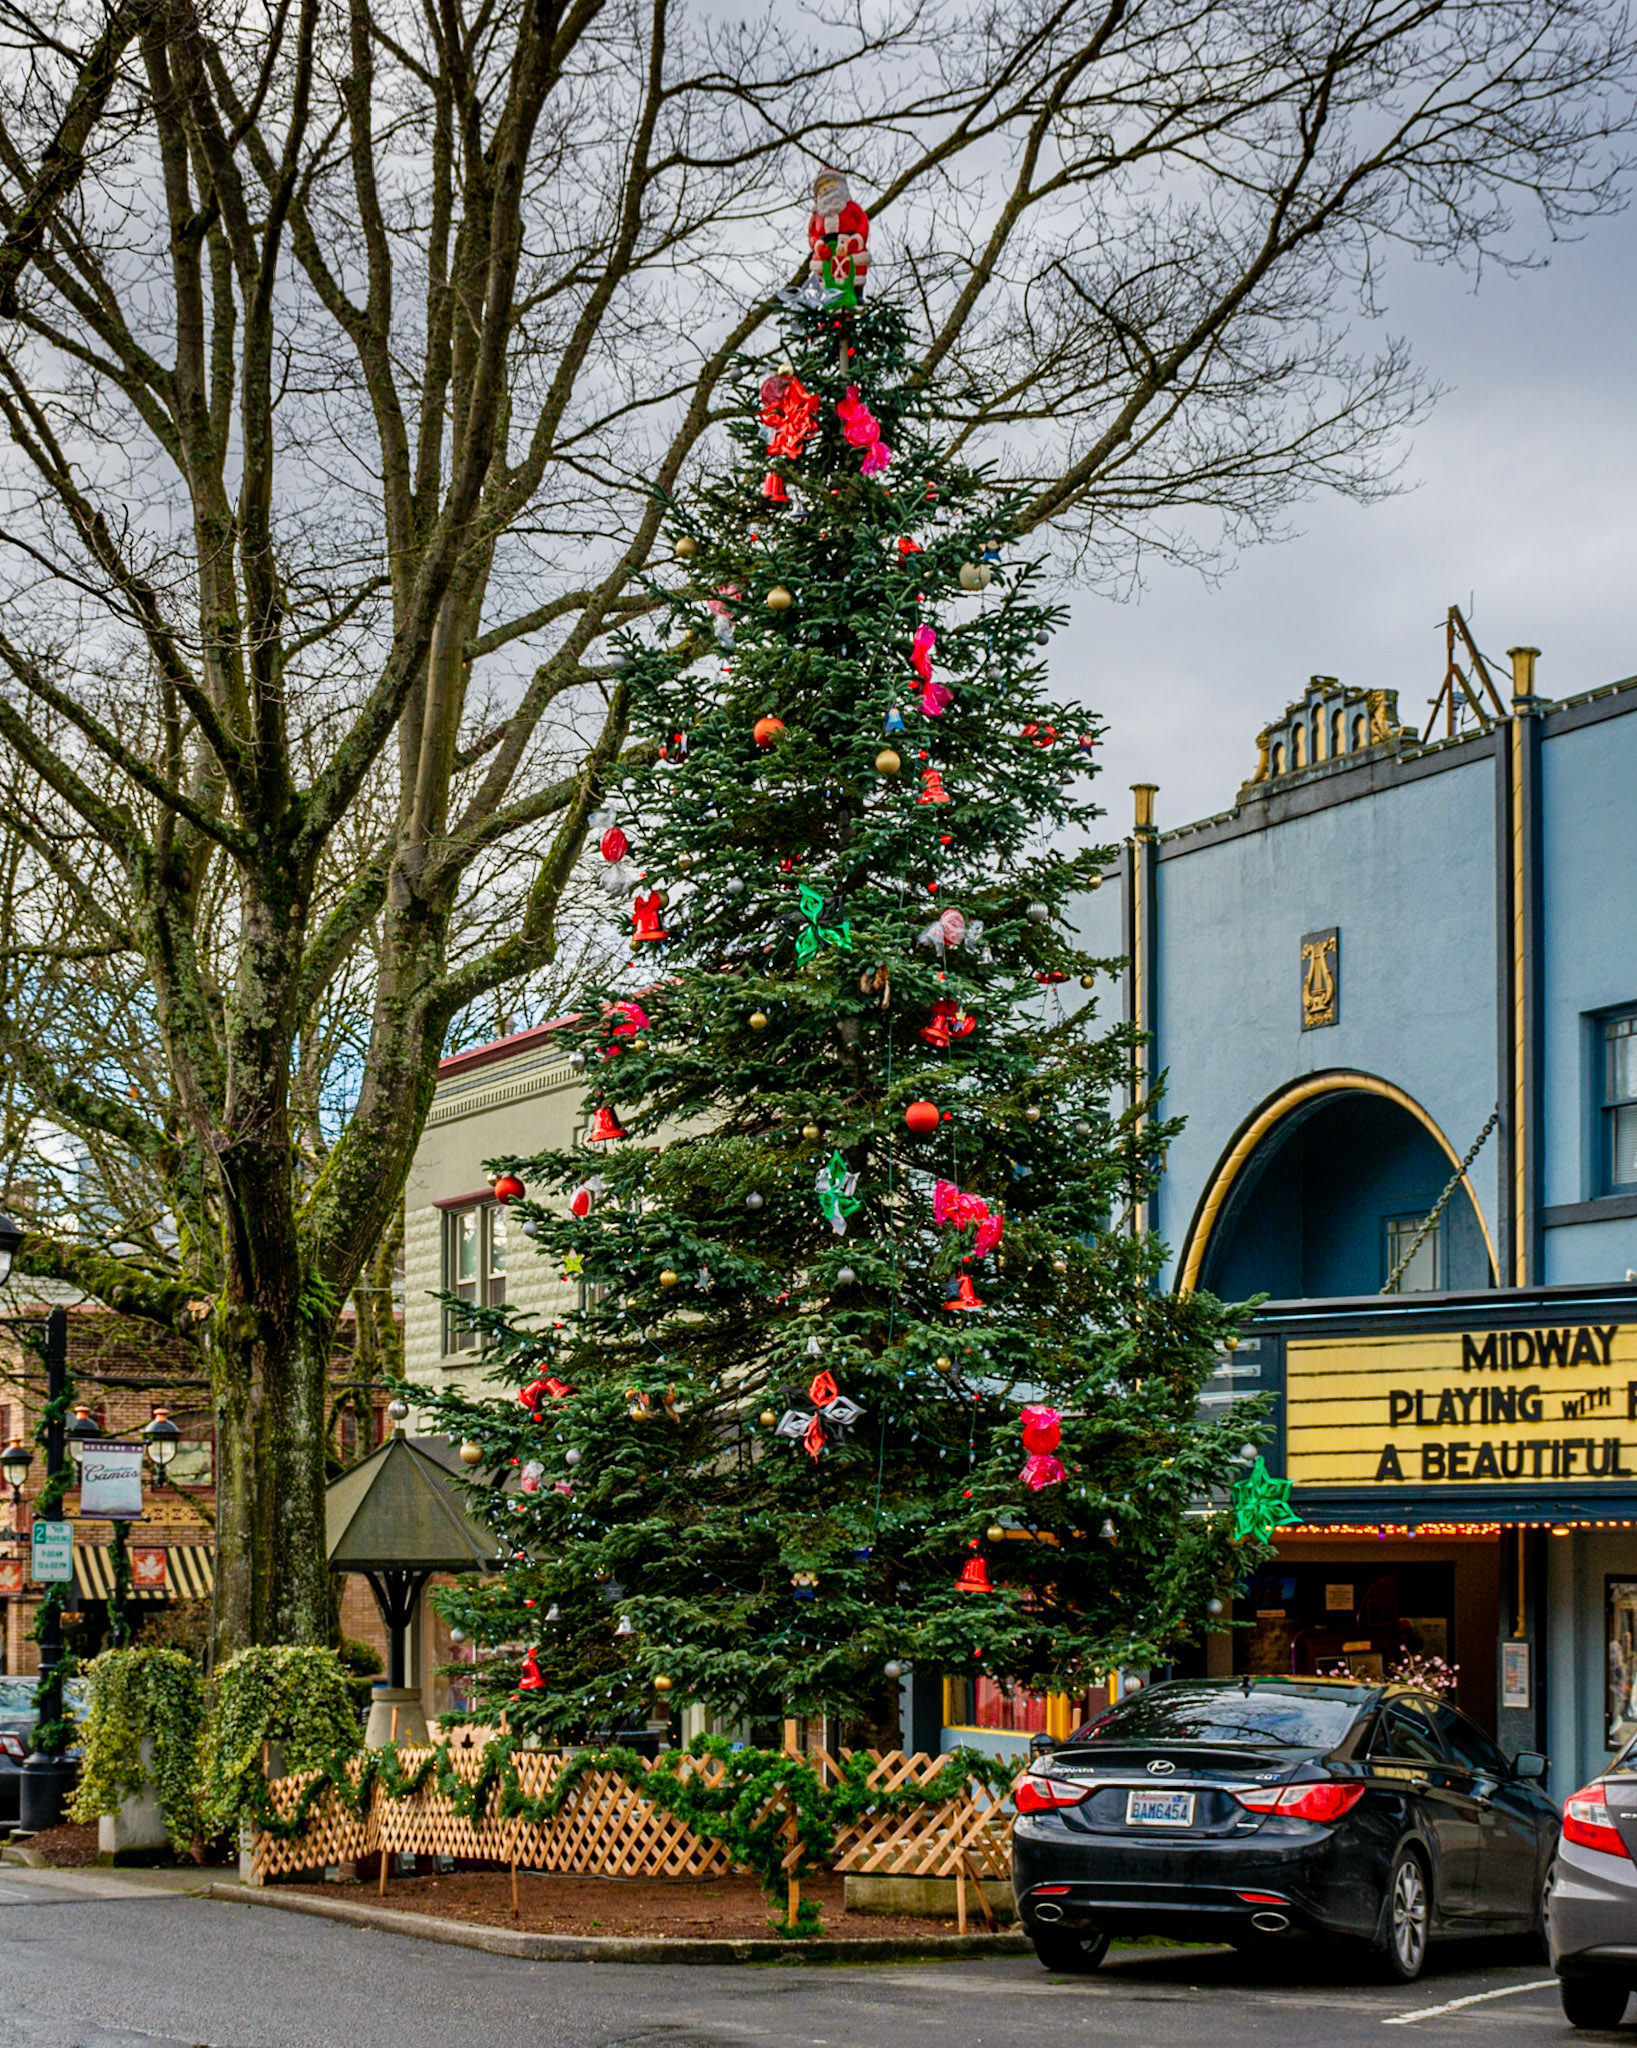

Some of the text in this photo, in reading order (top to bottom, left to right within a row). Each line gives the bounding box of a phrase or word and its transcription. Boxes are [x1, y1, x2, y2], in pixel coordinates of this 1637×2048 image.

[1461, 1325, 1619, 1373] MIDWAY
[1389, 1385, 1543, 1428] PLAYING
[1562, 1386, 1611, 1420] WITH
[84, 1463, 139, 1483] Camas
[1374, 1437, 1632, 1481] A BEAUTIFUL
[35, 1526, 45, 1542] 2
